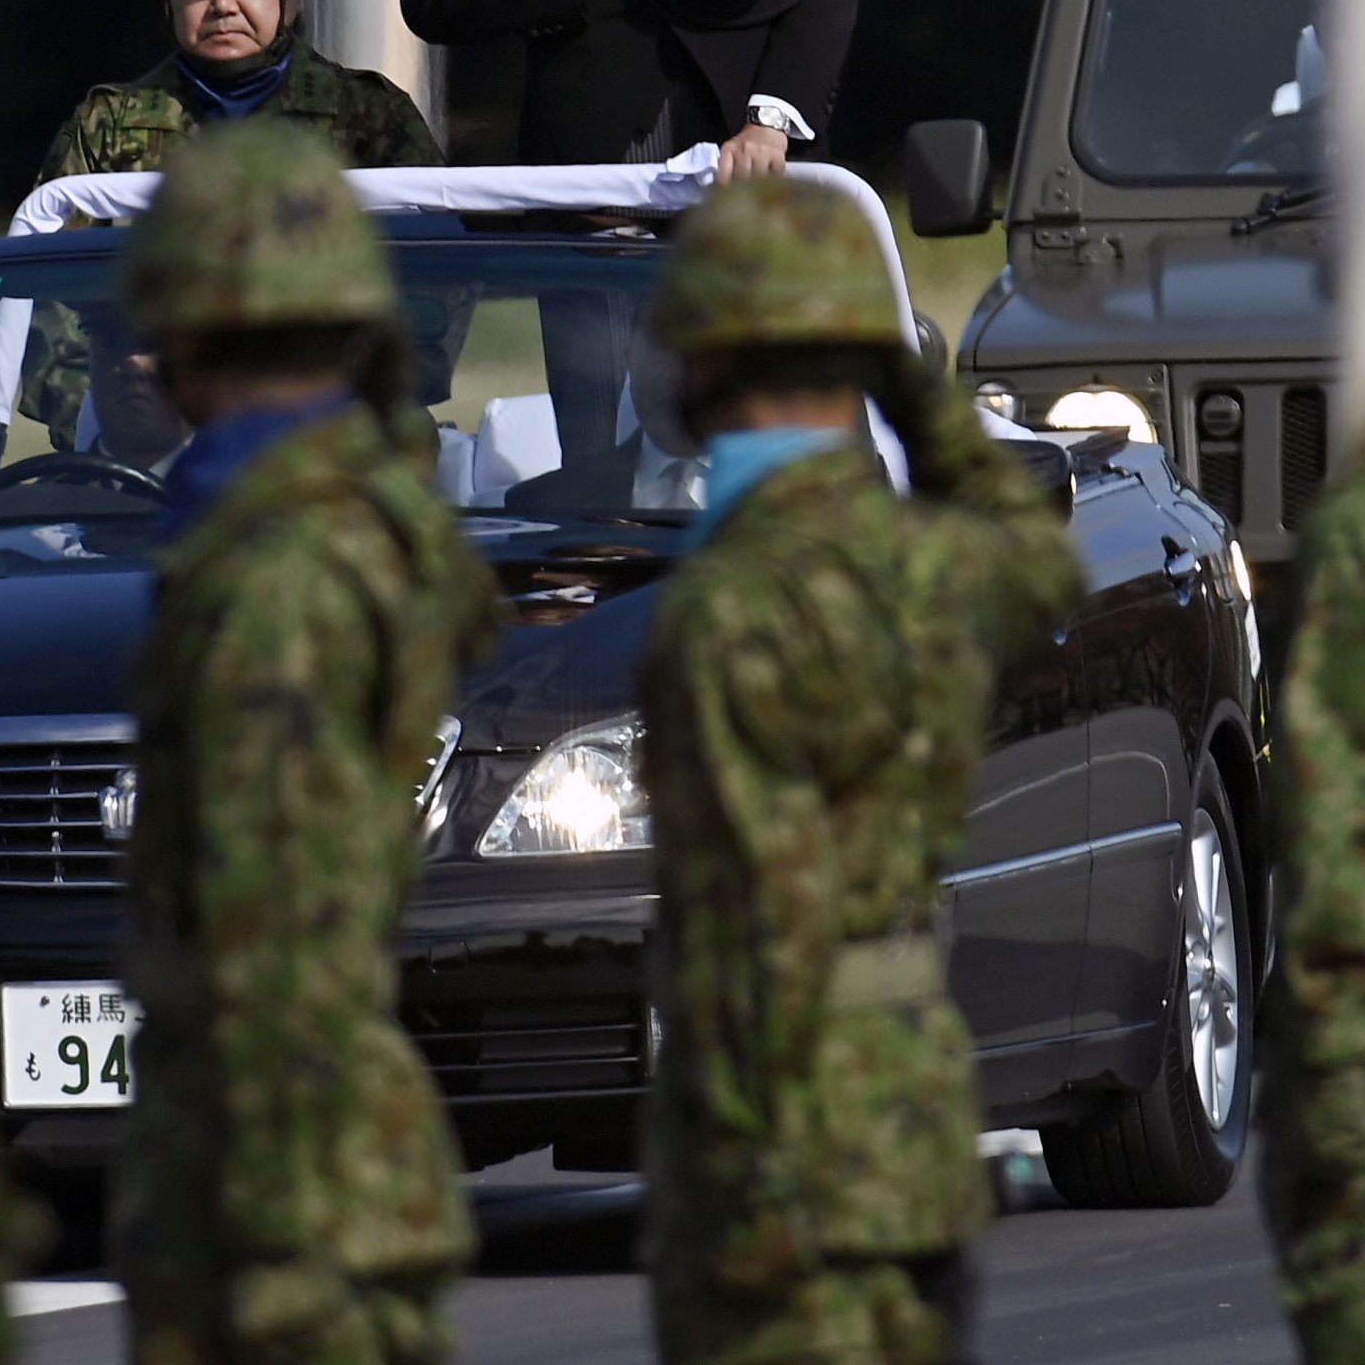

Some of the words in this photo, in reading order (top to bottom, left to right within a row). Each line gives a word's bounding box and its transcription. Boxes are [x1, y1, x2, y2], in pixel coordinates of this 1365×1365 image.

[62, 993, 126, 1024] 練馬
[25, 1052, 42, 1082] も
[58, 1034, 130, 1096] 94
